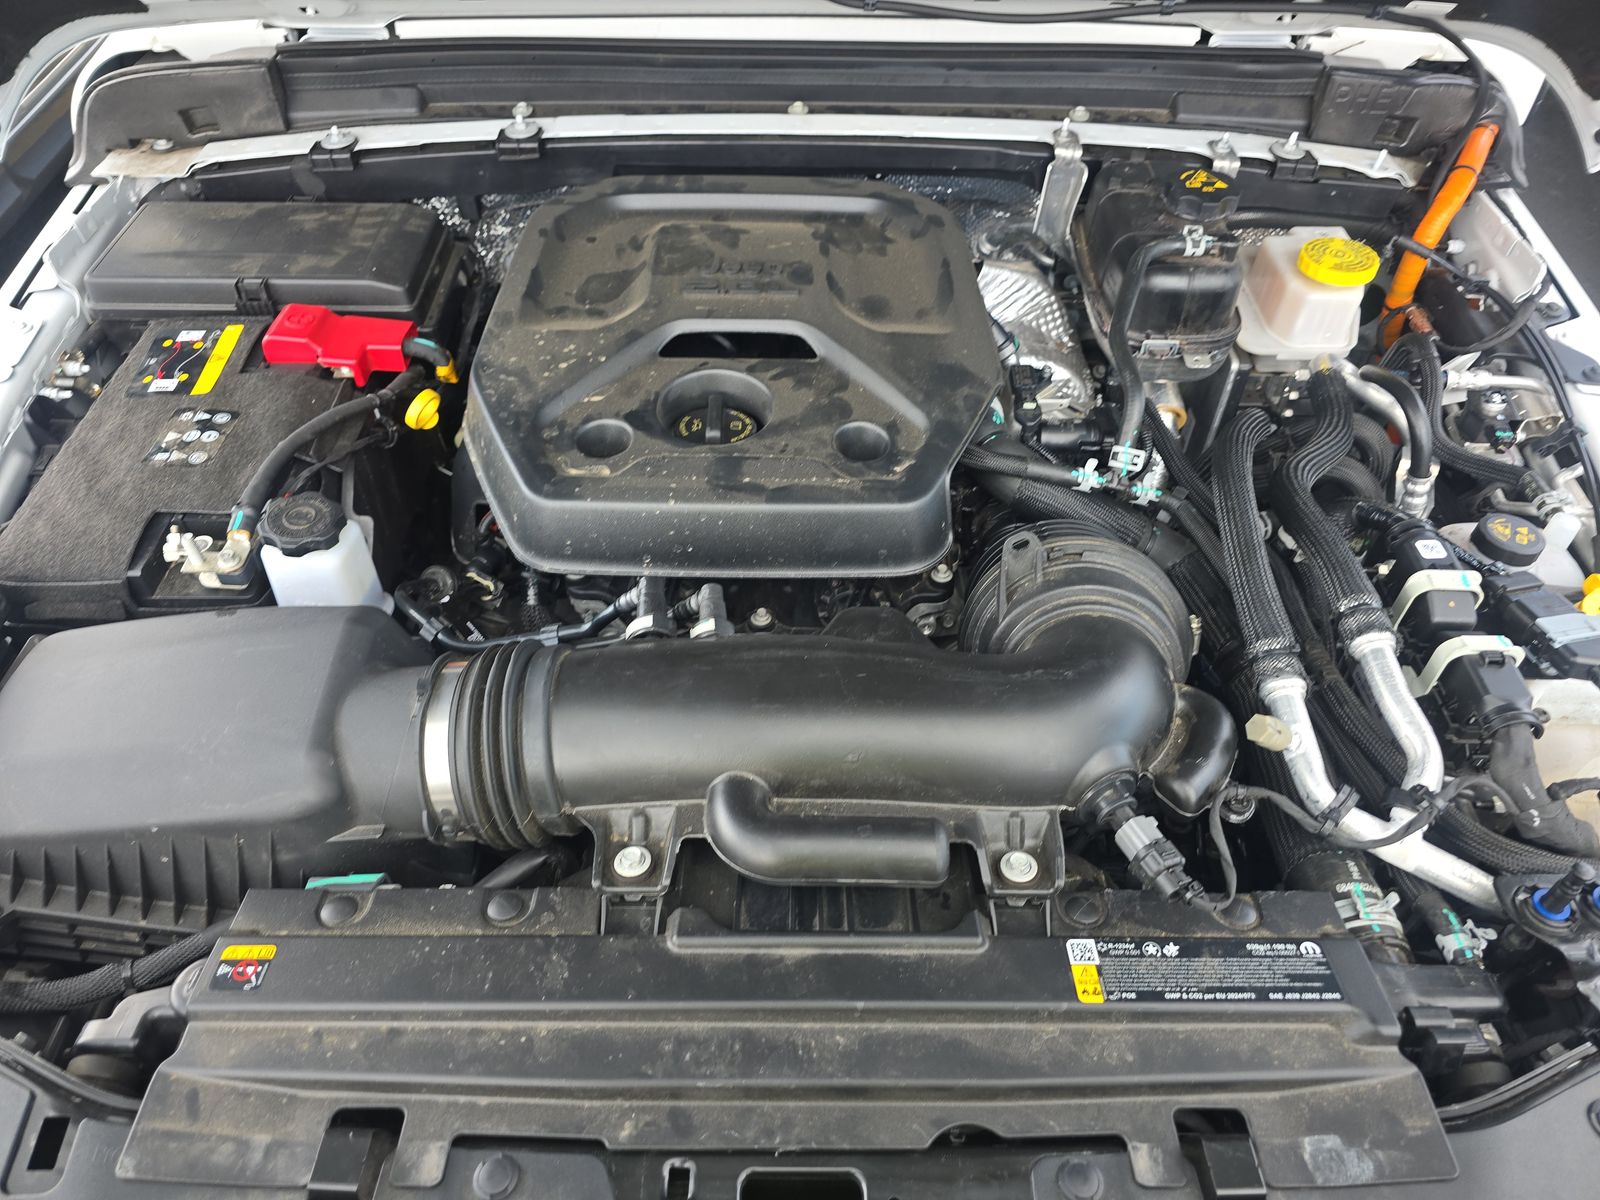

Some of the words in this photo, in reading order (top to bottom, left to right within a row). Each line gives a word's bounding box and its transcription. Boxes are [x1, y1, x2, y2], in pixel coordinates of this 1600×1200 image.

[1164, 992, 1181, 1000] GWP
[1188, 992, 1203, 1000] CO2
[1204, 993, 1215, 1001] per
[1268, 992, 1284, 1000] SAE
